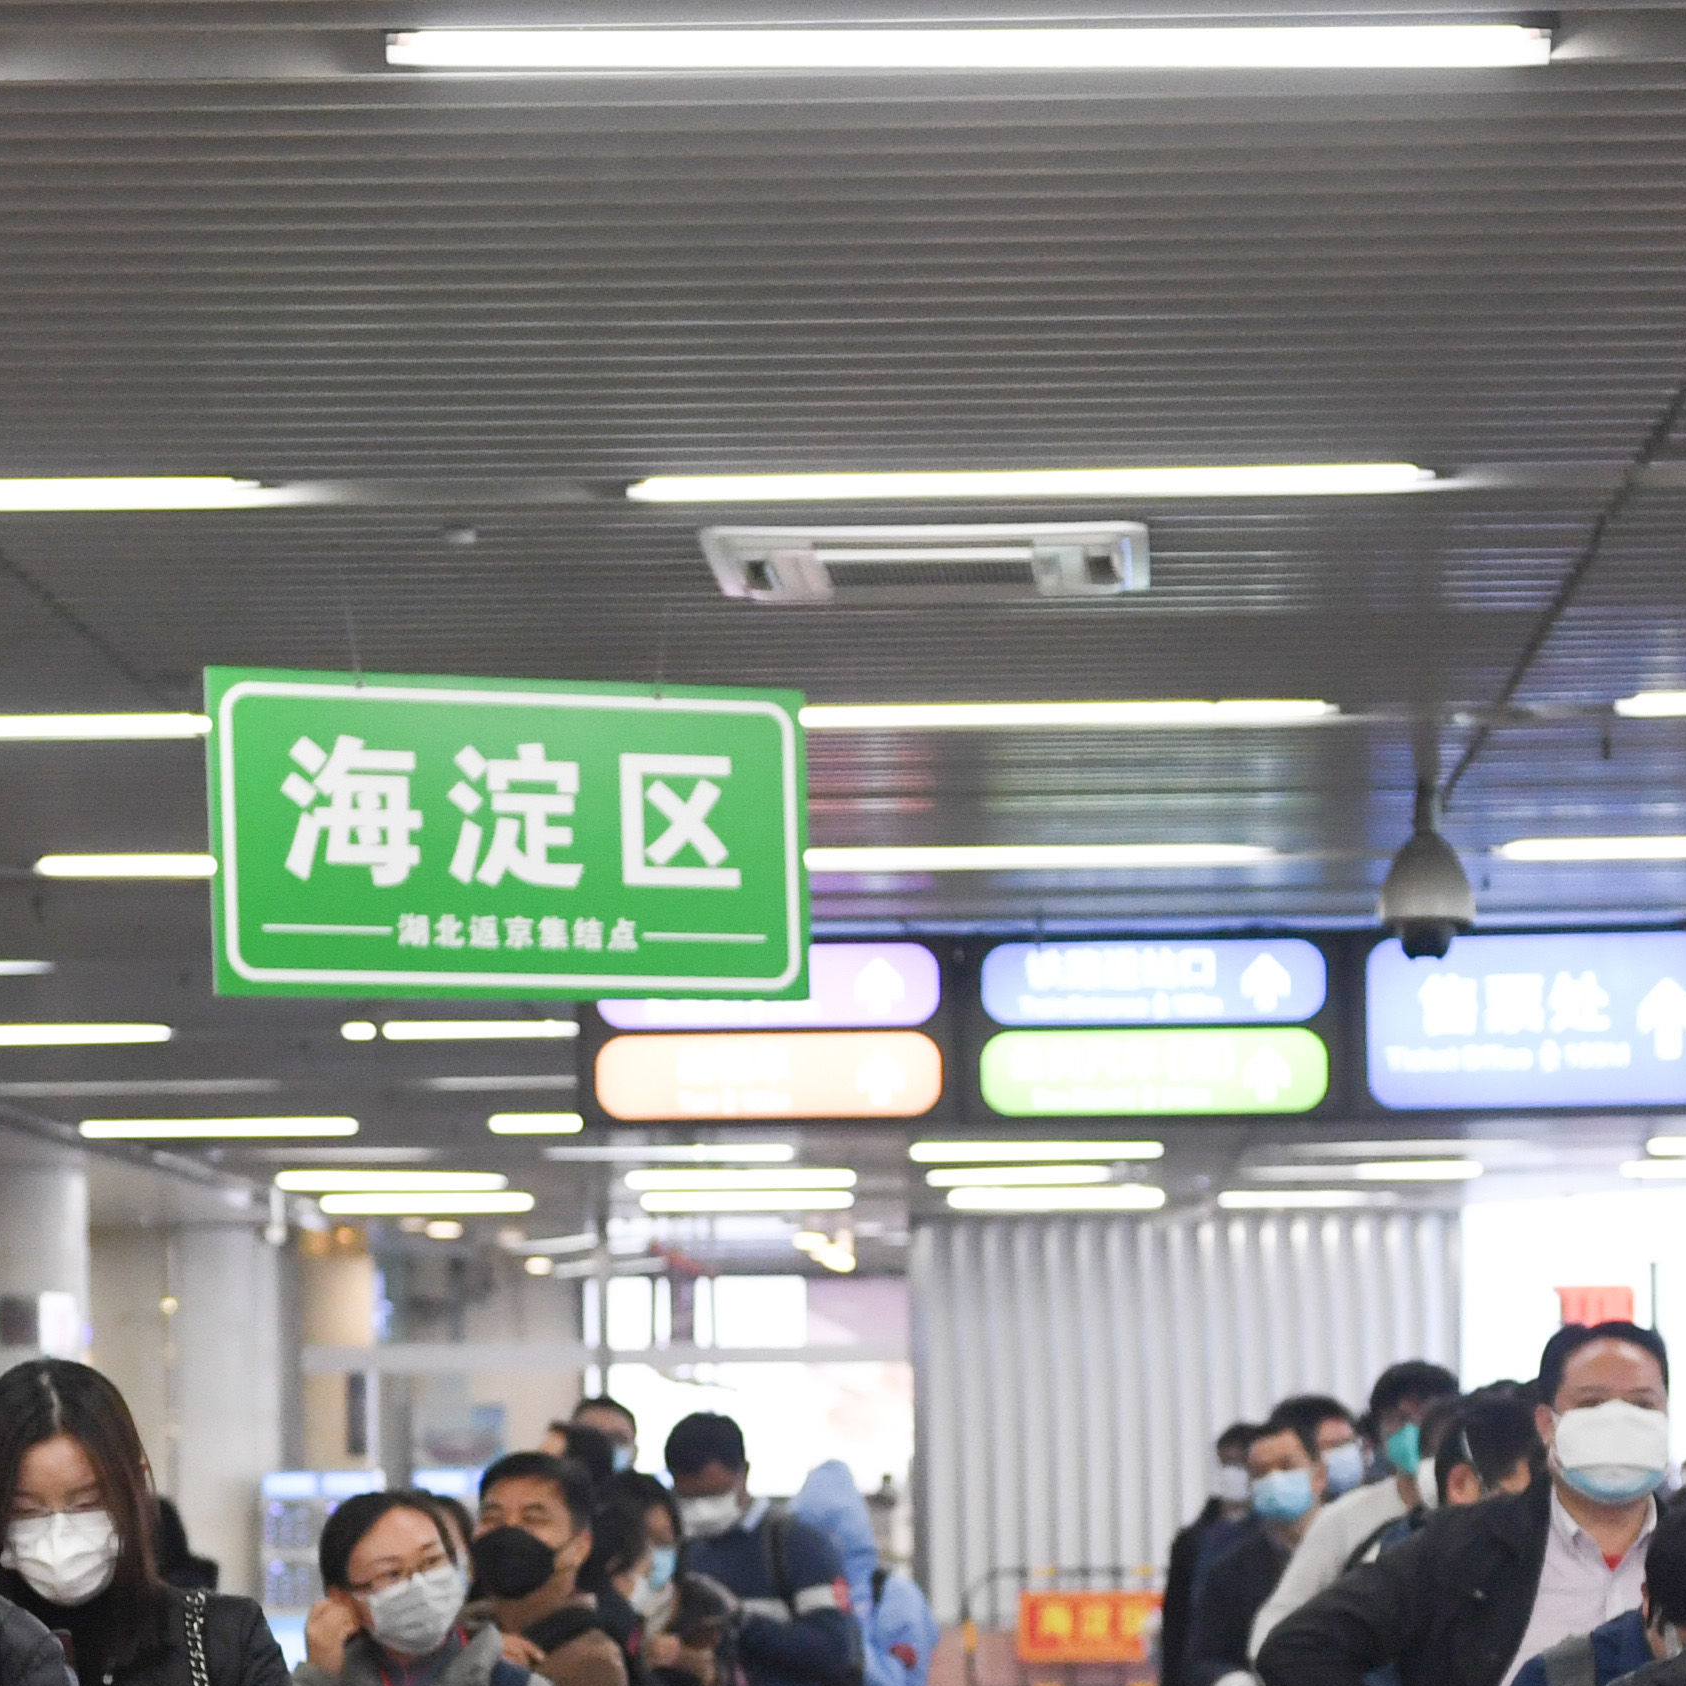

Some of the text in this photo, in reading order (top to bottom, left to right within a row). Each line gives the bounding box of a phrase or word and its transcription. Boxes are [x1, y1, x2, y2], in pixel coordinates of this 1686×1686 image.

[279, 733, 742, 890] 海淀区
[397, 912, 639, 952] 湖北返京集结点
